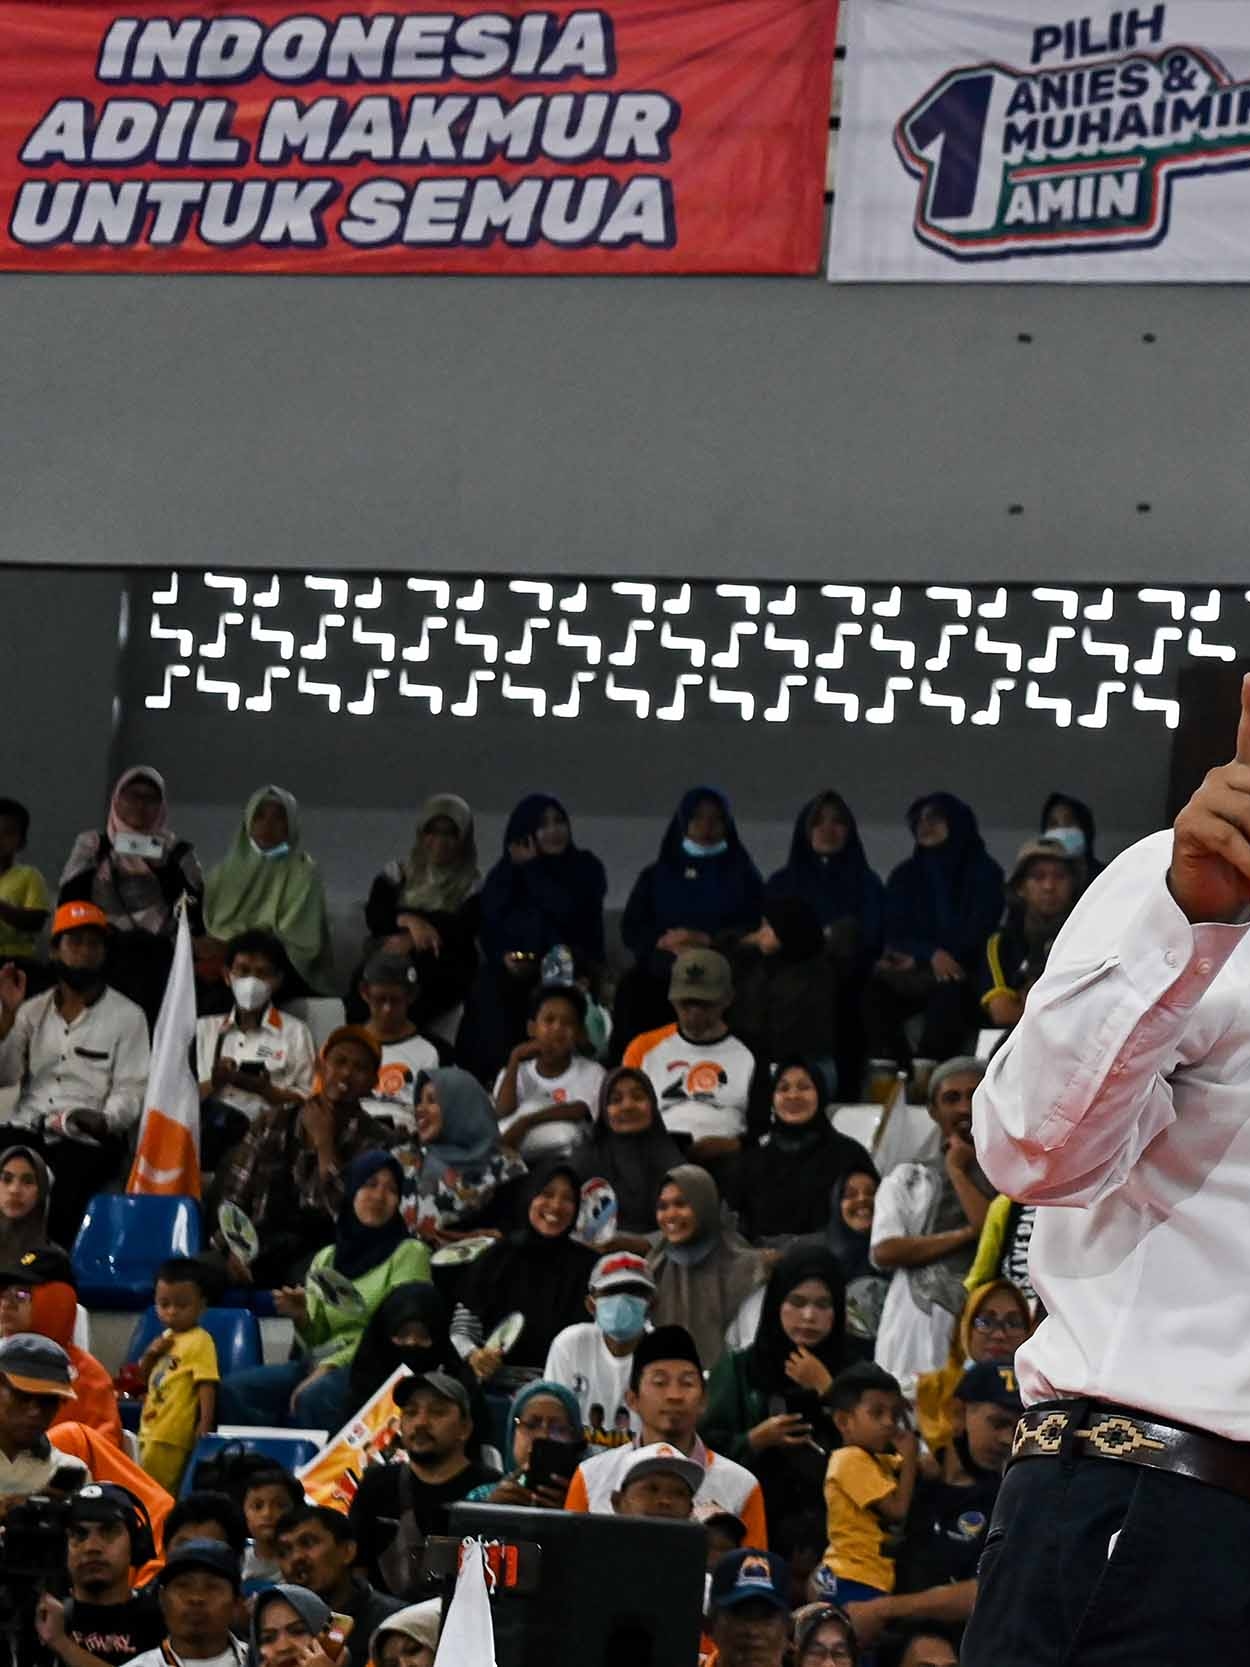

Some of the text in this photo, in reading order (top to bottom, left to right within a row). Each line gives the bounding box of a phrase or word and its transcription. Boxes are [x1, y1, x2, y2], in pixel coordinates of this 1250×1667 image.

[97, 11, 611, 81] INDONESIA
[1030, 4, 1166, 65] PILIH
[1004, 53, 1199, 118] ANIES &
[21, 92, 673, 162] ADIL MAKMUR
[908, 74, 995, 220] 1
[9, 176, 668, 246] UNTUK SEMUA
[1003, 172, 1139, 225] AMIN
